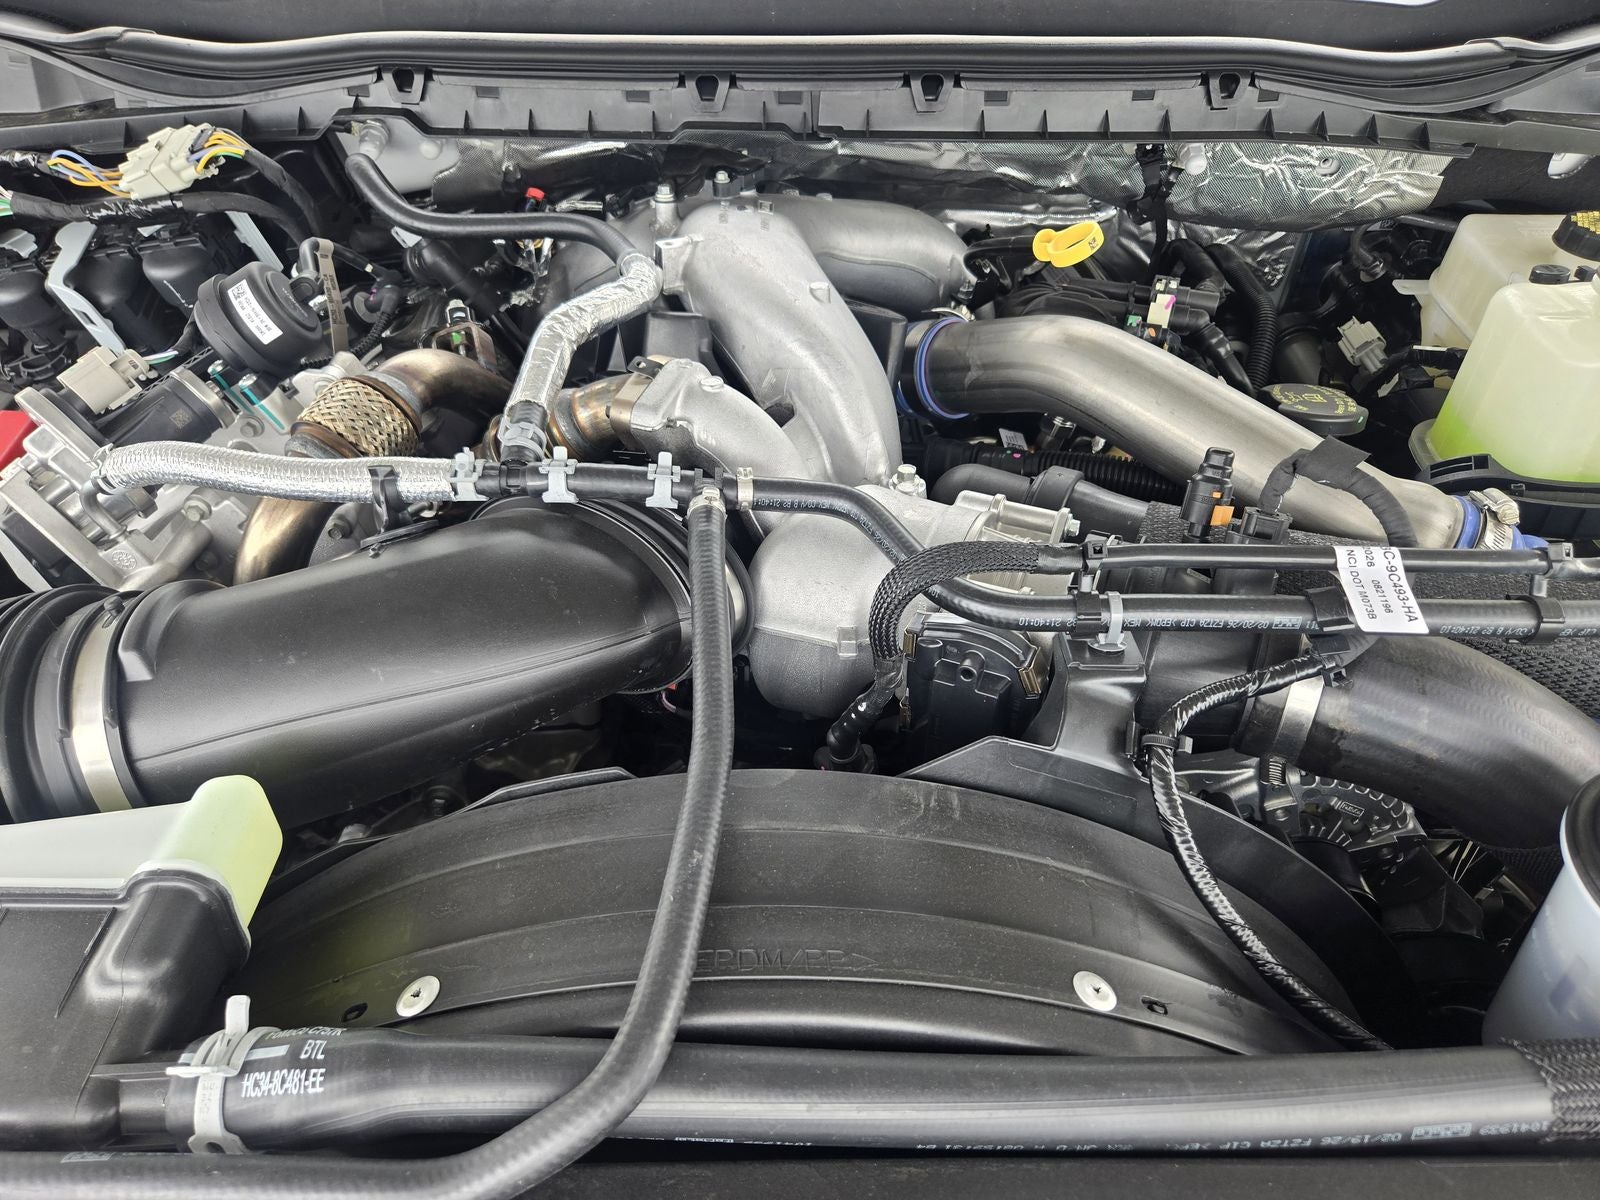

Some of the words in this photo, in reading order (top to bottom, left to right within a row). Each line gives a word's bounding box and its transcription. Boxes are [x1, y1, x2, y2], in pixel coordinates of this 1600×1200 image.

[1350, 570, 1365, 590] DOT
[1018, 617, 1062, 627] 21:40:10
[300, 1039, 327, 1059] BTL
